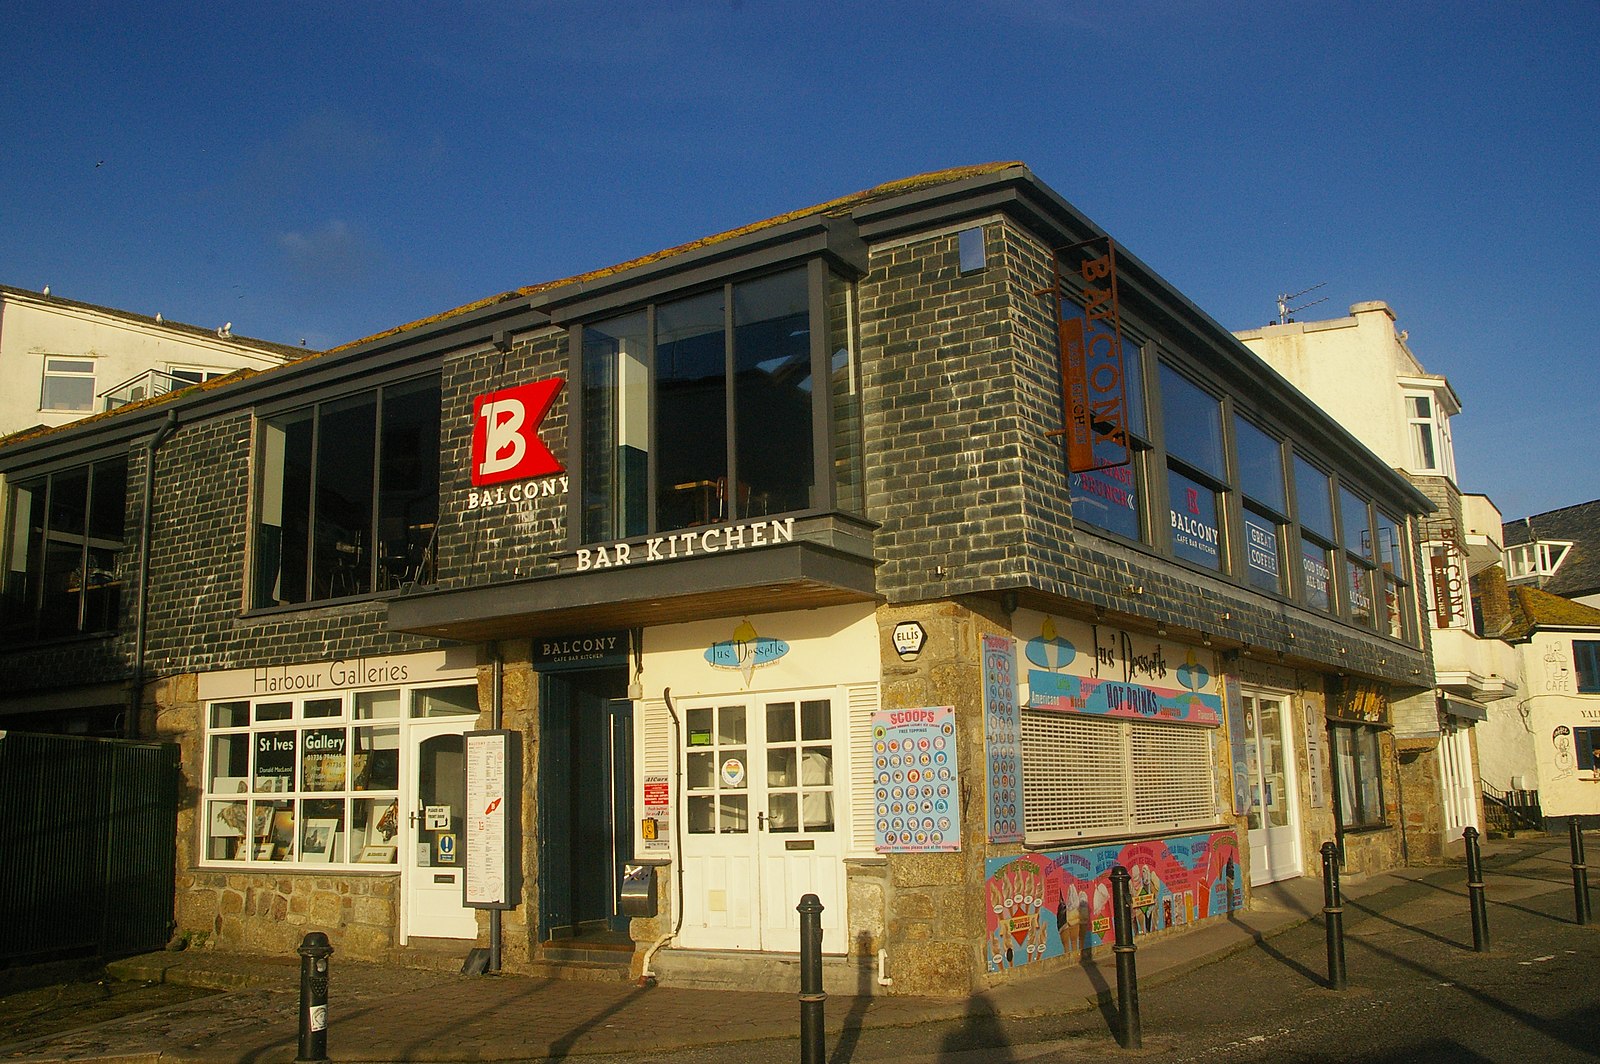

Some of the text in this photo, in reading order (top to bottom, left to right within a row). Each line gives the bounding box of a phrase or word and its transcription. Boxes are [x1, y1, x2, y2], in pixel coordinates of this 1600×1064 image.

[1081, 254, 1124, 448] BALCONY
[480, 398, 526, 476] B
[468, 476, 569, 510] BALCONY
[1081, 472, 1128, 508] BRUNCH
[1170, 509, 1218, 546] BALCONY
[1176, 533, 1188, 545] CAFE
[1251, 528, 1272, 549] GREAT
[576, 517, 795, 571] BAR KITCHEN
[1251, 549, 1276, 571] COFFEE
[1440, 526, 1465, 619] BALCONY
[543, 636, 617, 656] BALCONY
[737, 638, 785, 664] Desserts
[896, 630, 919, 642] ELLIS
[1119, 630, 1167, 683] Desserts
[254, 657, 408, 693] Harbour Galleries
[1031, 690, 1060, 706] Americano
[1106, 683, 1123, 711] HOT
[1126, 686, 1158, 715] DRINKS
[890, 710, 935, 725] SCOOPS
[259, 737, 294, 752] St Ives
[305, 734, 345, 752] Gallery
[1305, 704, 1317, 802] Galleries
